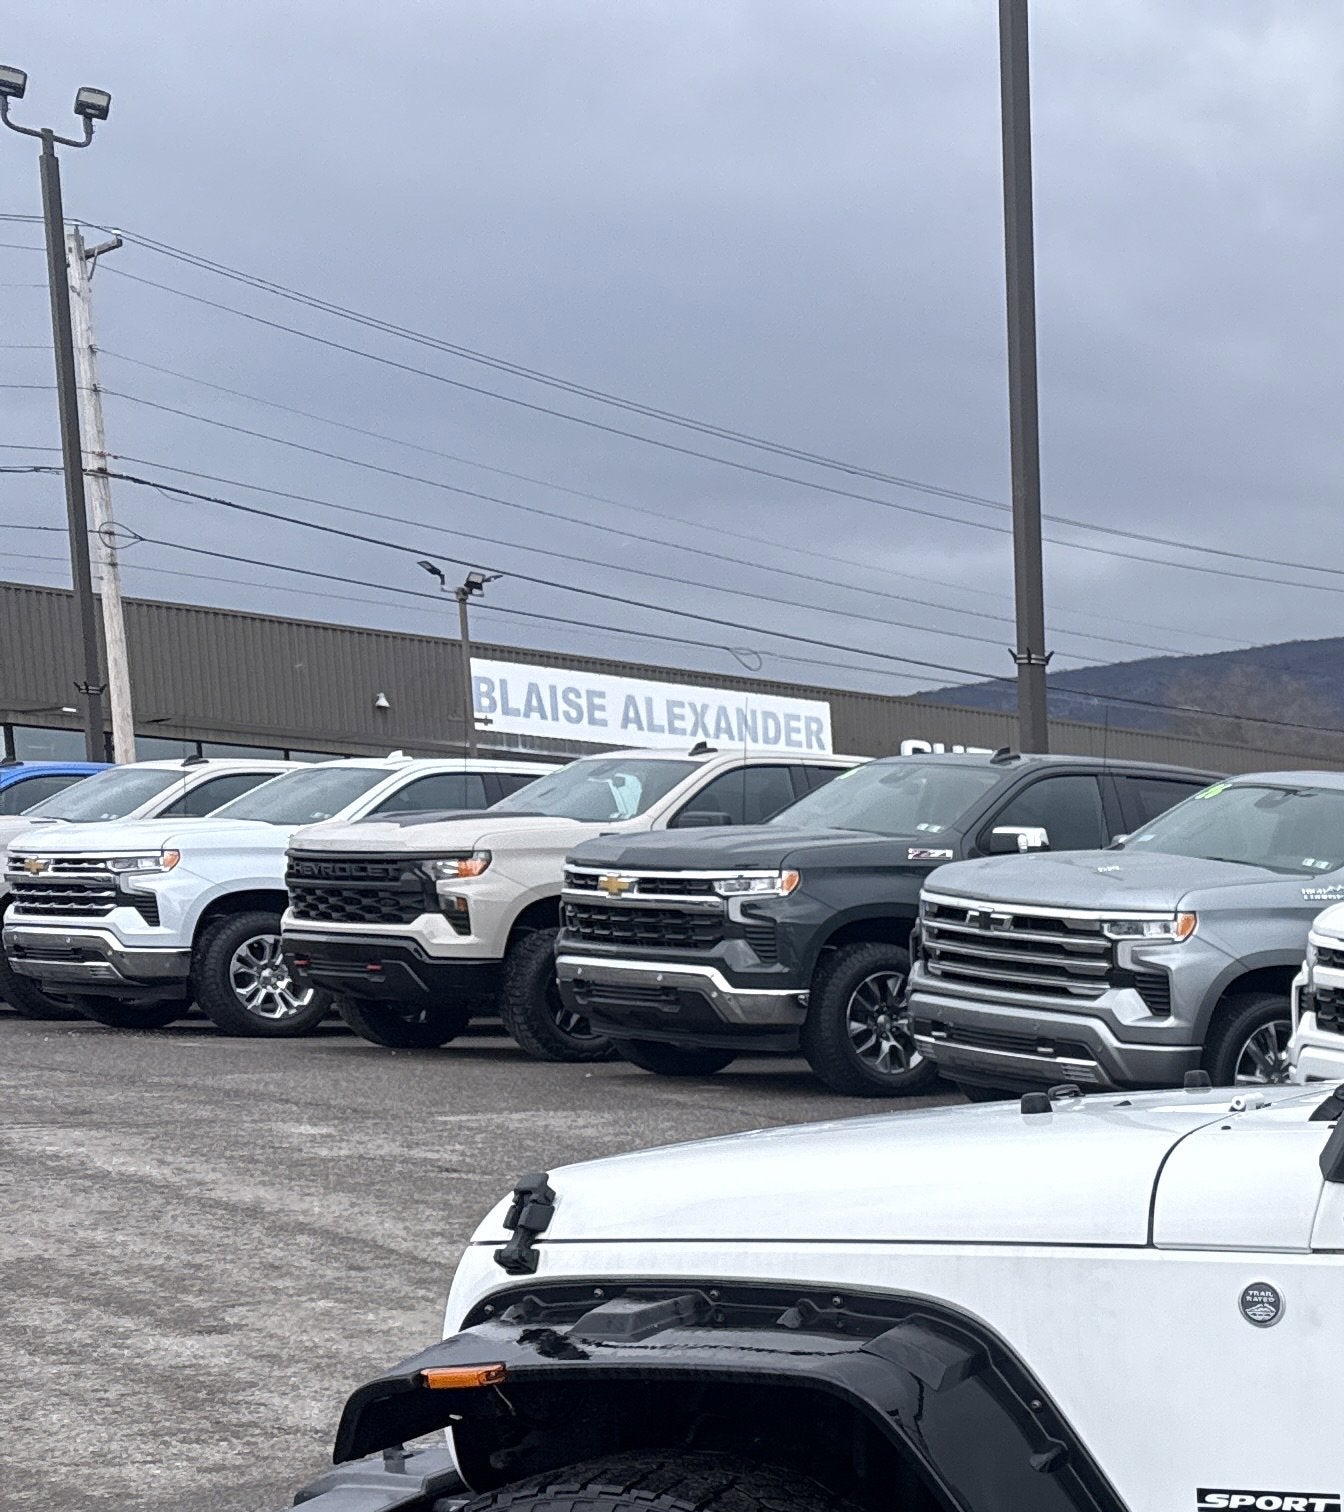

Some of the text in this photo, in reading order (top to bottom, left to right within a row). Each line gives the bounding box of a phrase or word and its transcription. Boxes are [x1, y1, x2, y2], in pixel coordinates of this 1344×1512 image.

[473, 675, 826, 751] BLAISE ALEXANDER
[1245, 1295, 1276, 1303] RATED
[1198, 1492, 1341, 1512] SPORT
